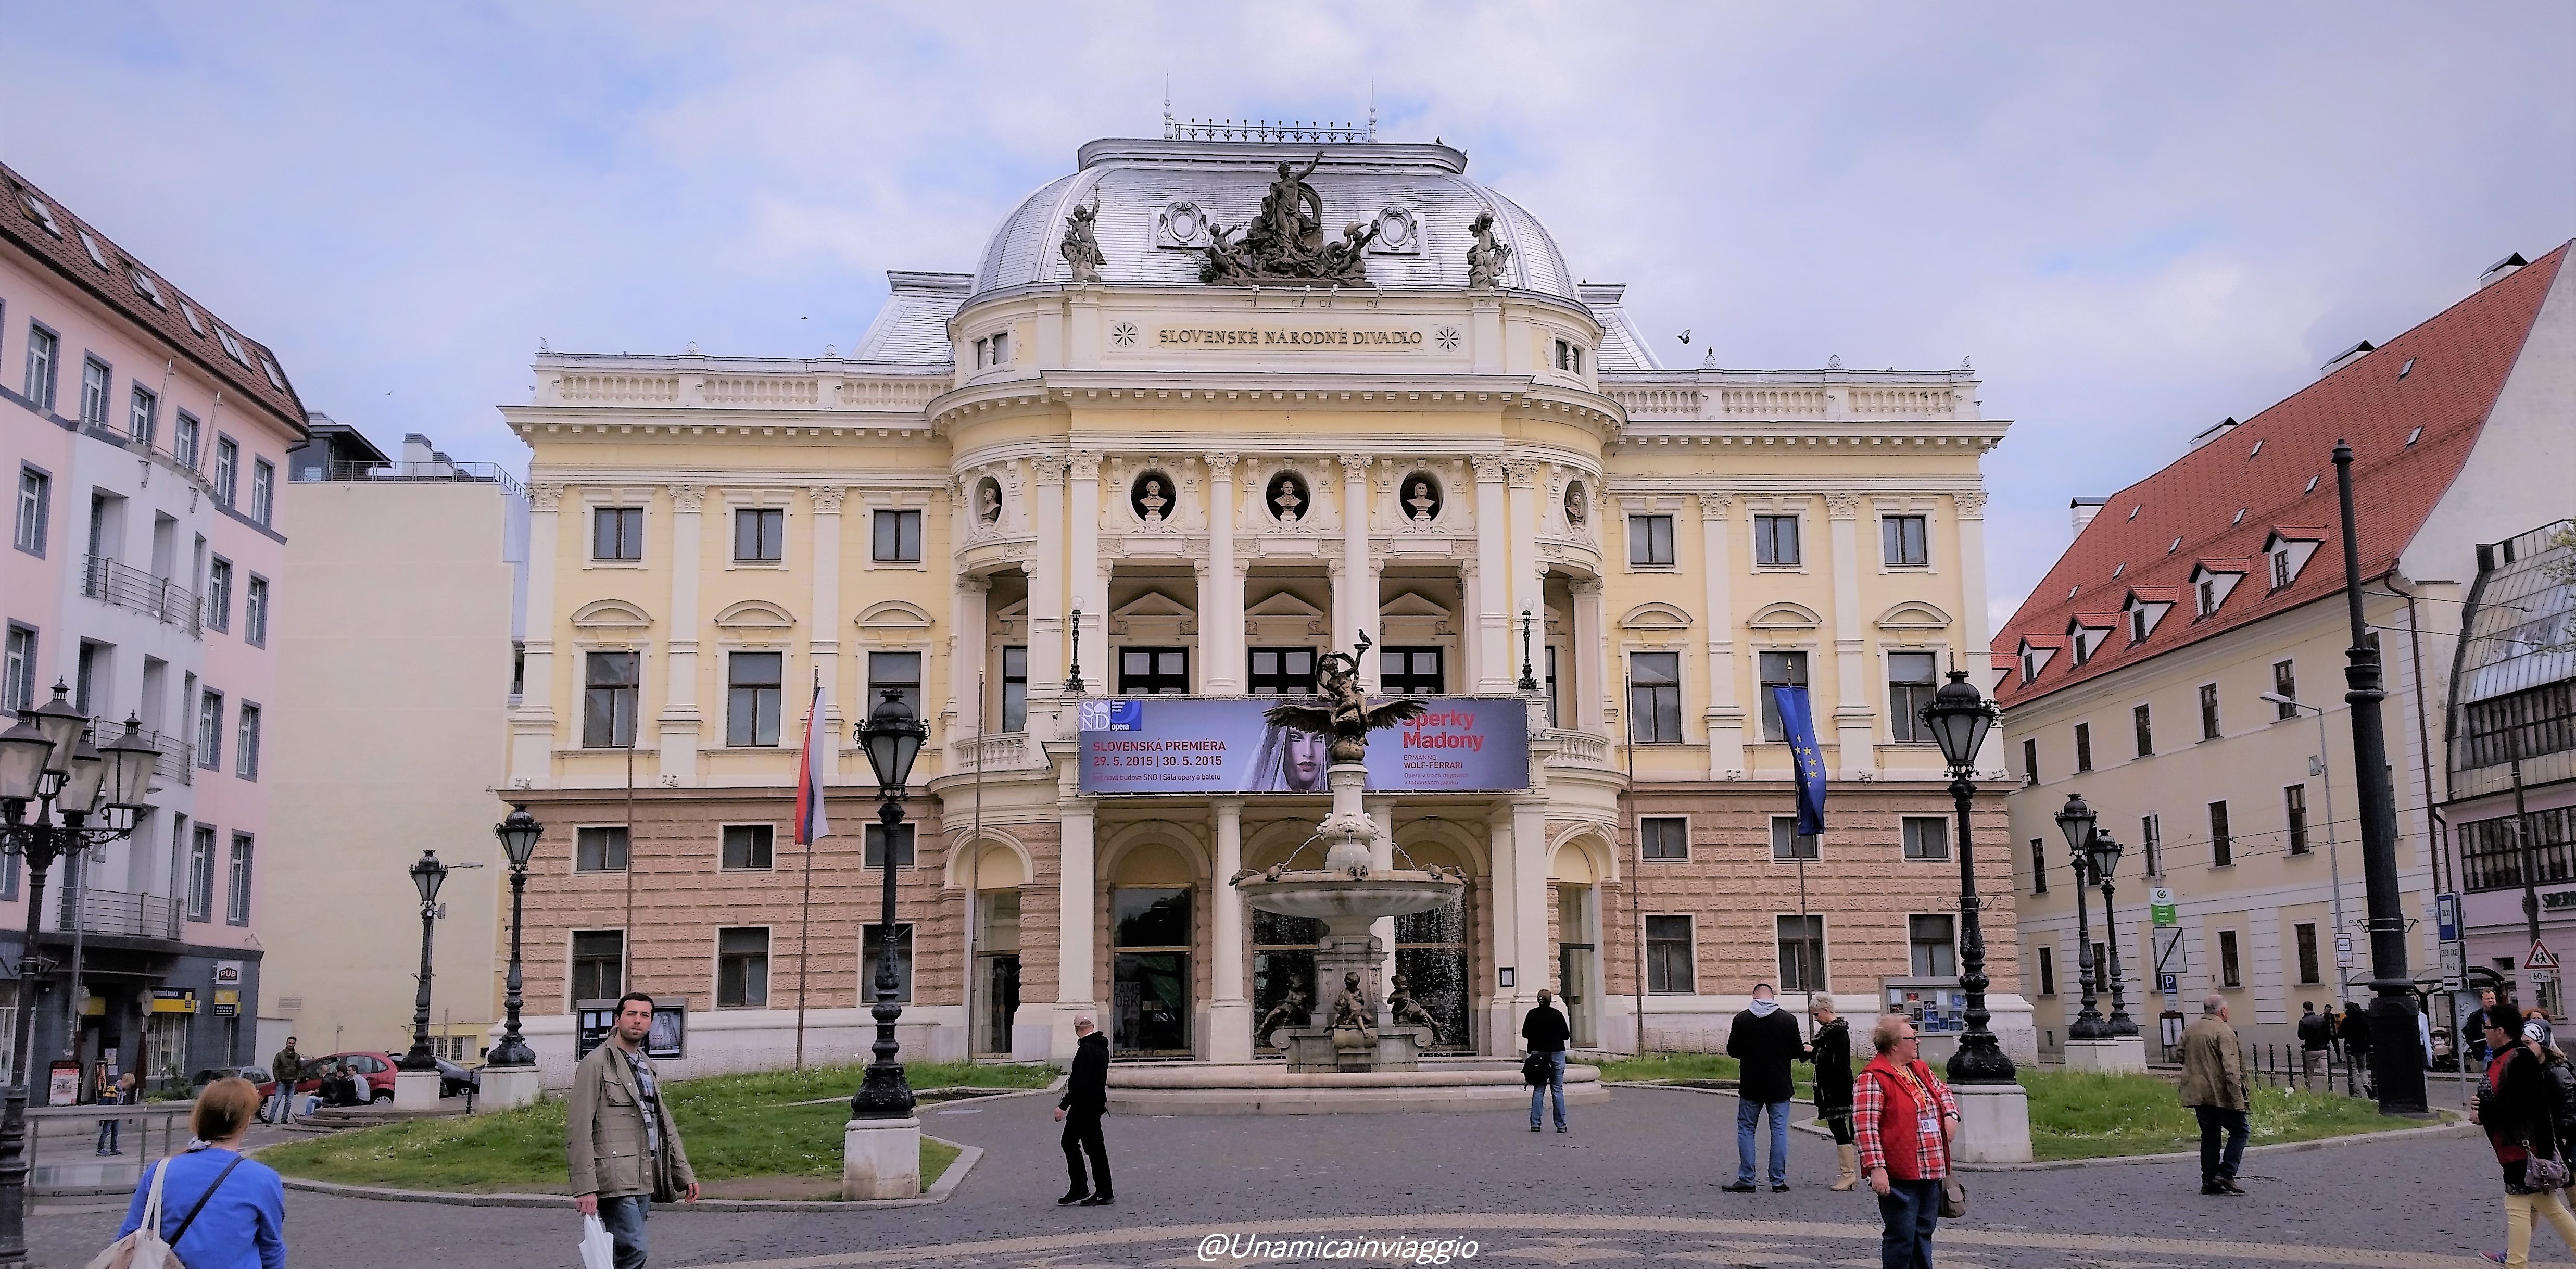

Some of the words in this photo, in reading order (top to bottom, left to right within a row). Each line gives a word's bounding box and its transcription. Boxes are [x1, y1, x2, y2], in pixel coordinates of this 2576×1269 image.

[1159, 328, 1258, 344] SLOVENSKÉ
[1265, 328, 1347, 344] NÁRODNÉ
[1353, 331, 1422, 344] DIVADLO
[1093, 738, 1163, 751] SLOVENSKÁ
[1166, 738, 1226, 751] PREMIÉRA
[1404, 731, 1484, 752] Madony
[1093, 757, 1109, 767] 29.
[1113, 757, 1122, 767] 5.
[1126, 757, 1153, 767] 2015
[1163, 756, 1179, 767] 30.
[1182, 756, 1192, 766] 5.
[1195, 756, 1222, 766] 2015
[2166, 976, 2174, 987] P
